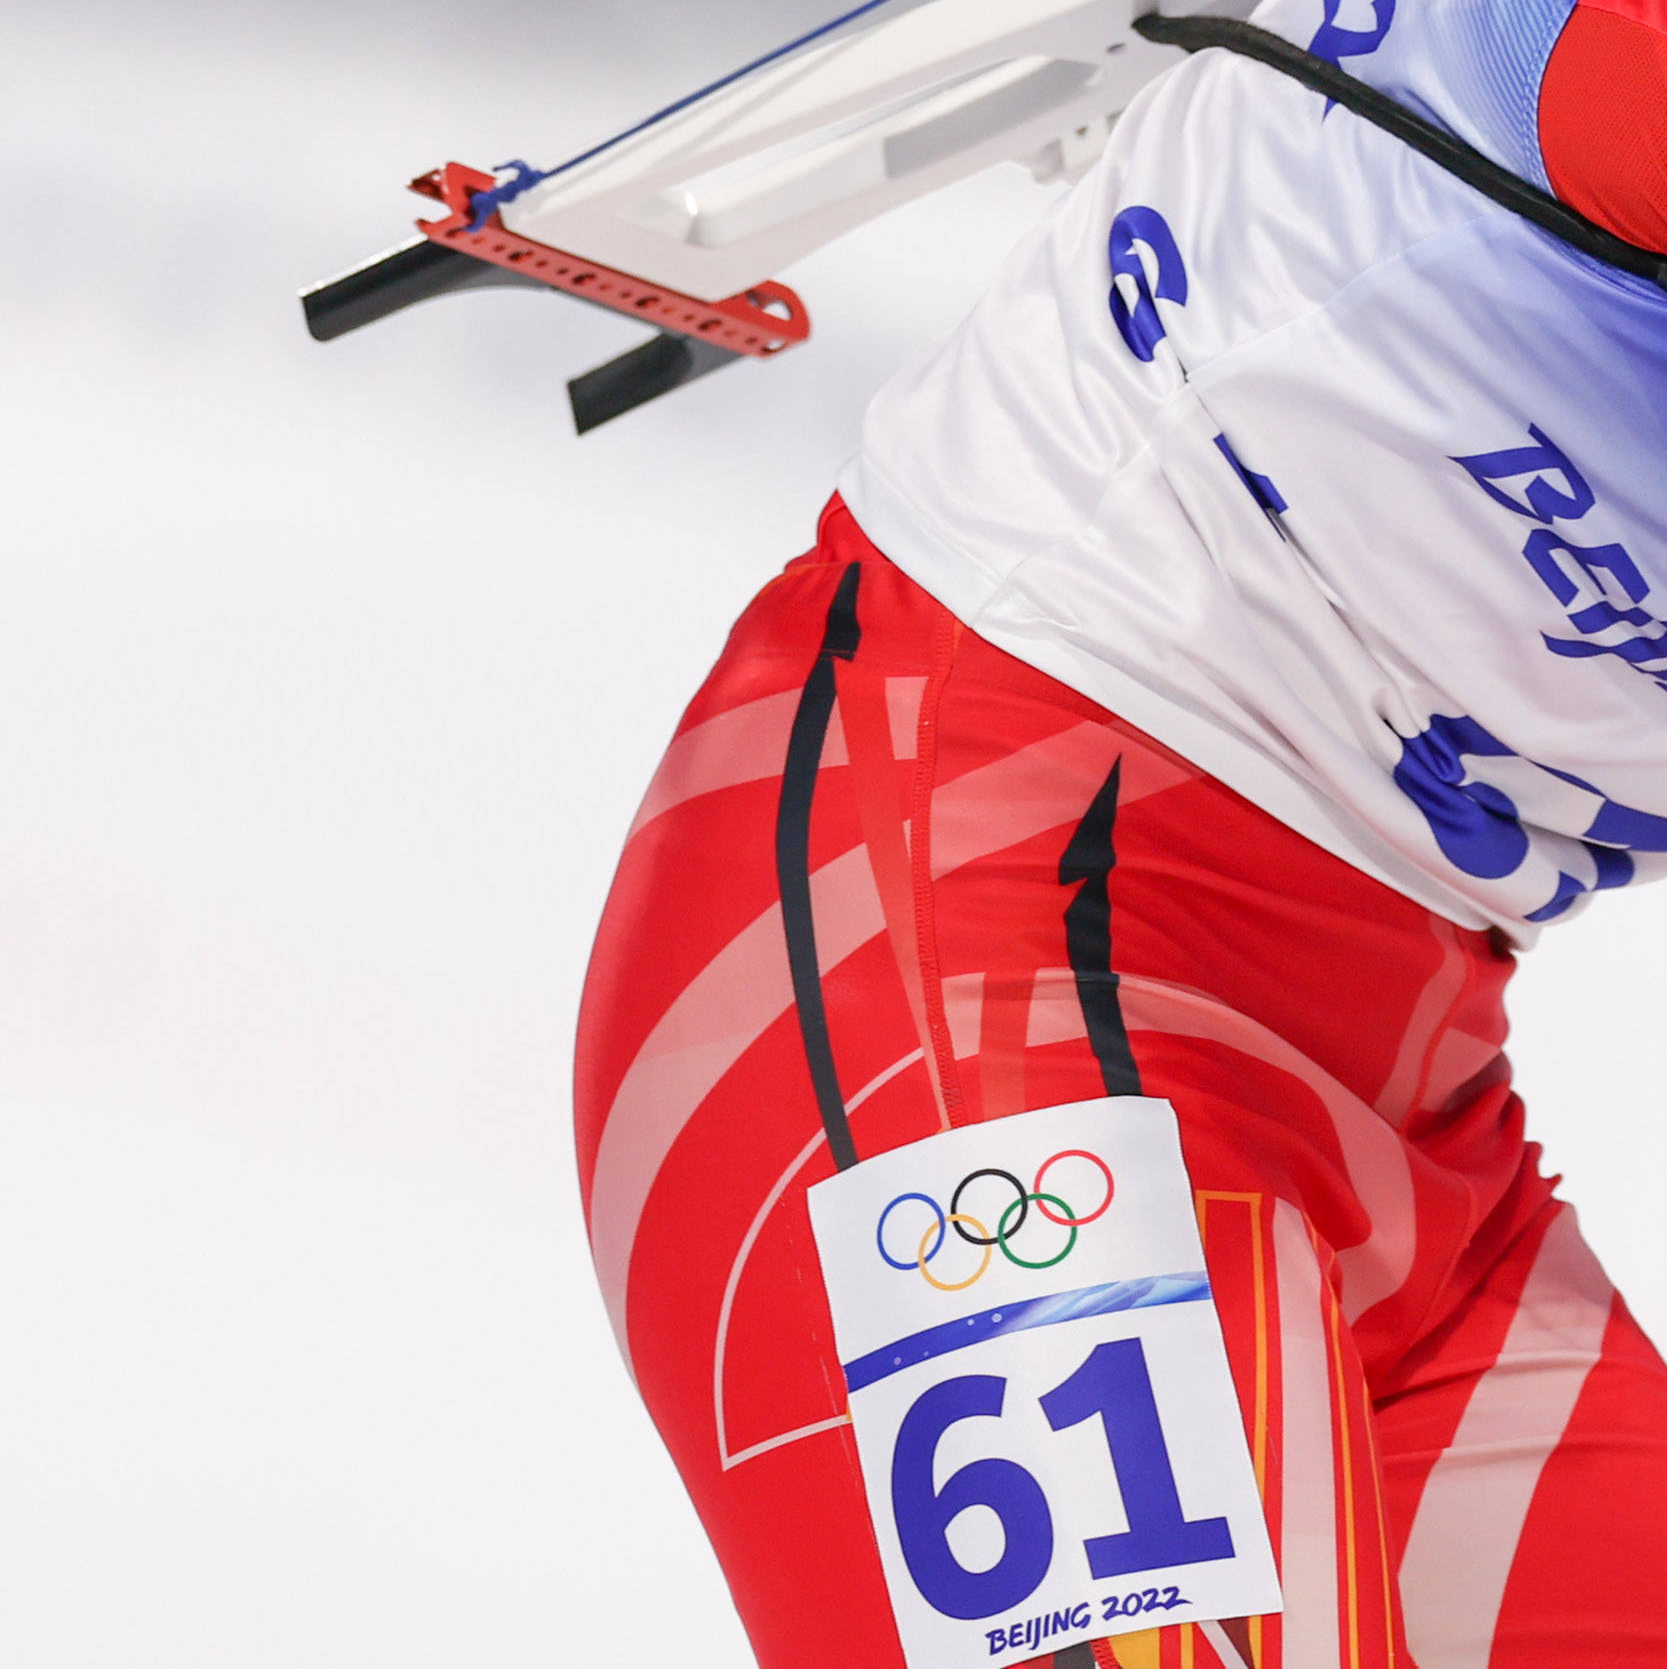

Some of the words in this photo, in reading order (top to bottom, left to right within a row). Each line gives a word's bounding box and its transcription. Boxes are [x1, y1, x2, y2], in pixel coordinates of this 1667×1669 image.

[891, 1336, 1236, 1621] 61
[984, 1601, 1092, 1657] BEIJING
[1101, 1585, 1194, 1622] 2022
